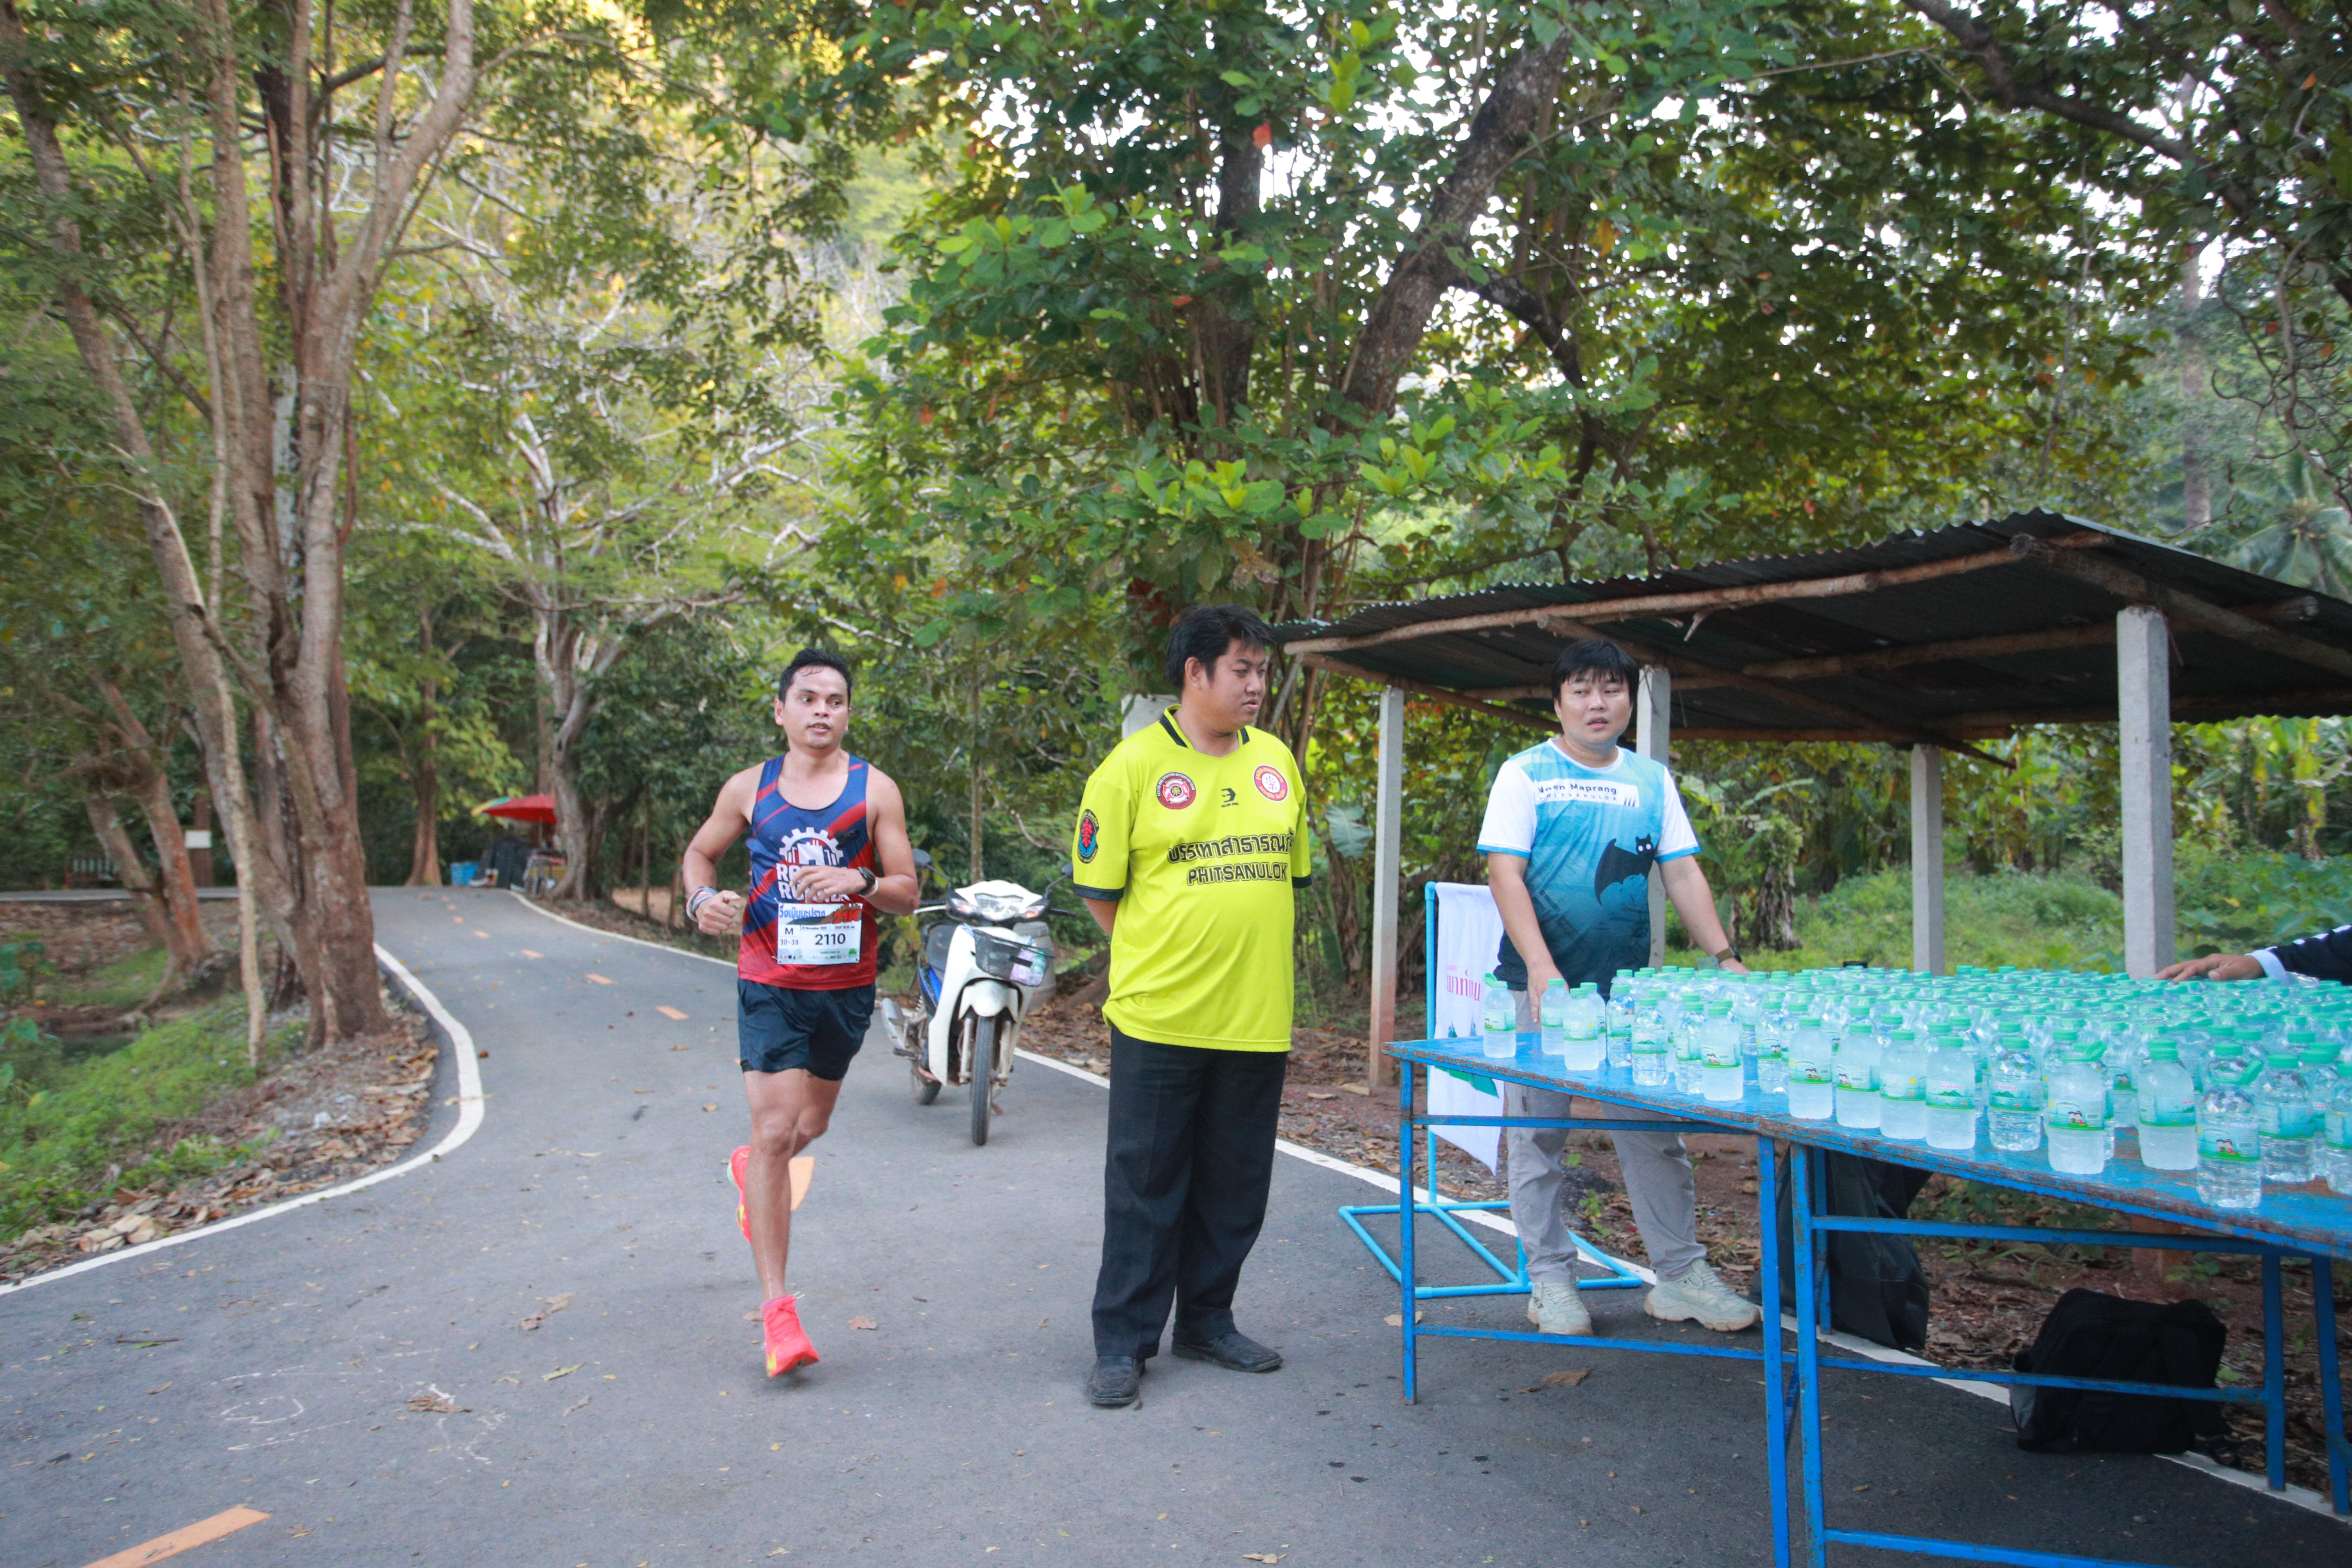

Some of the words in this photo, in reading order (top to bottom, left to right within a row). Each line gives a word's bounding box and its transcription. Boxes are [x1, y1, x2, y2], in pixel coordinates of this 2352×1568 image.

[1538, 785, 1565, 793] Noen
[1570, 784, 1617, 795] Maprang
[1187, 862, 1288, 885] PHITSANULOK
[833, 909, 860, 924] 21K
[815, 933, 846, 945] 2110
